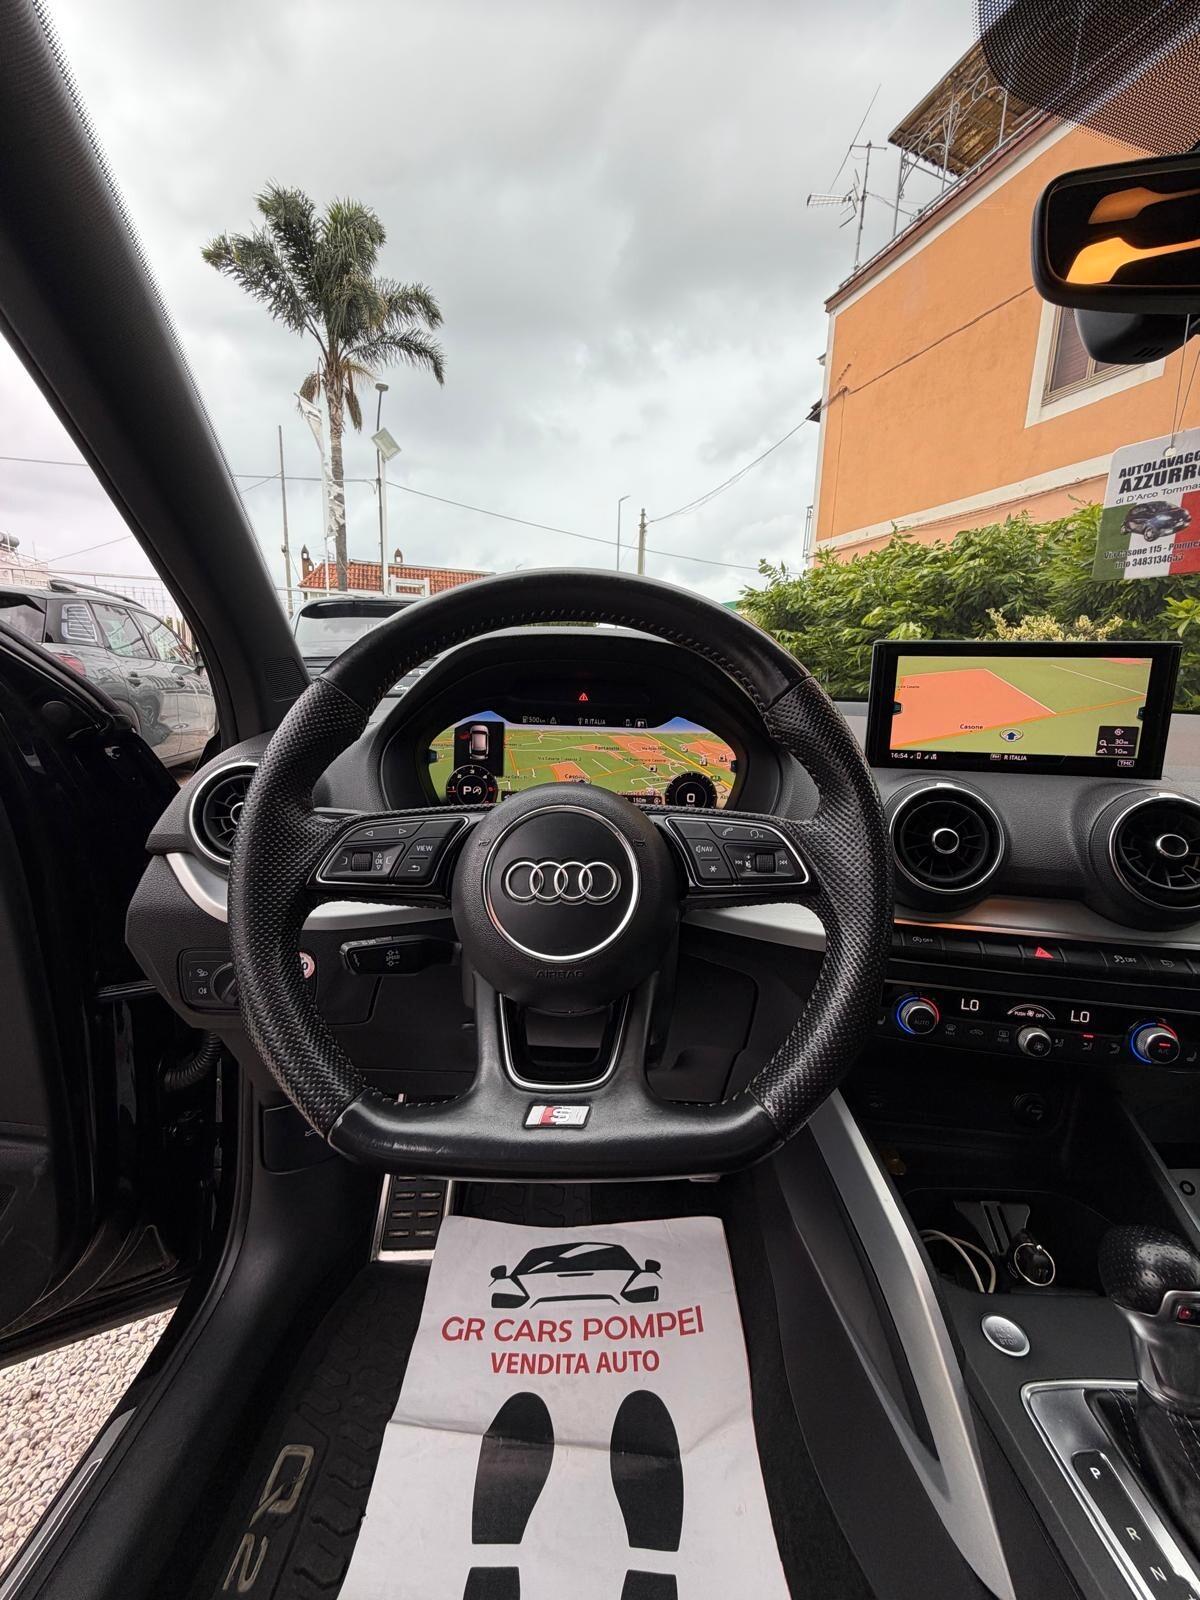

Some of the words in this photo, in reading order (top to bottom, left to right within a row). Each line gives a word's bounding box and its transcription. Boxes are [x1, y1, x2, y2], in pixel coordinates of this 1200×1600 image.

[1118, 464, 1200, 494] AZZURR
[1115, 497, 1124, 505] di
[1126, 491, 1159, 502] D'Arco
[1150, 544, 1162, 554] 115
[463, 786, 472, 795] P
[686, 793, 696, 803] 0
[536, 969, 584, 979] AIRBAG
[961, 998, 979, 1011] LO
[1070, 1009, 1090, 1023] LO
[441, 1315, 486, 1342] GR
[493, 1318, 573, 1343] CARS
[583, 1304, 705, 1341] POMPEI
[490, 1351, 590, 1375] VENDITA
[596, 1349, 661, 1374] AUTO
[1089, 1467, 1101, 1480] P
[1125, 1526, 1142, 1541] R
[1149, 1565, 1168, 1582] N
